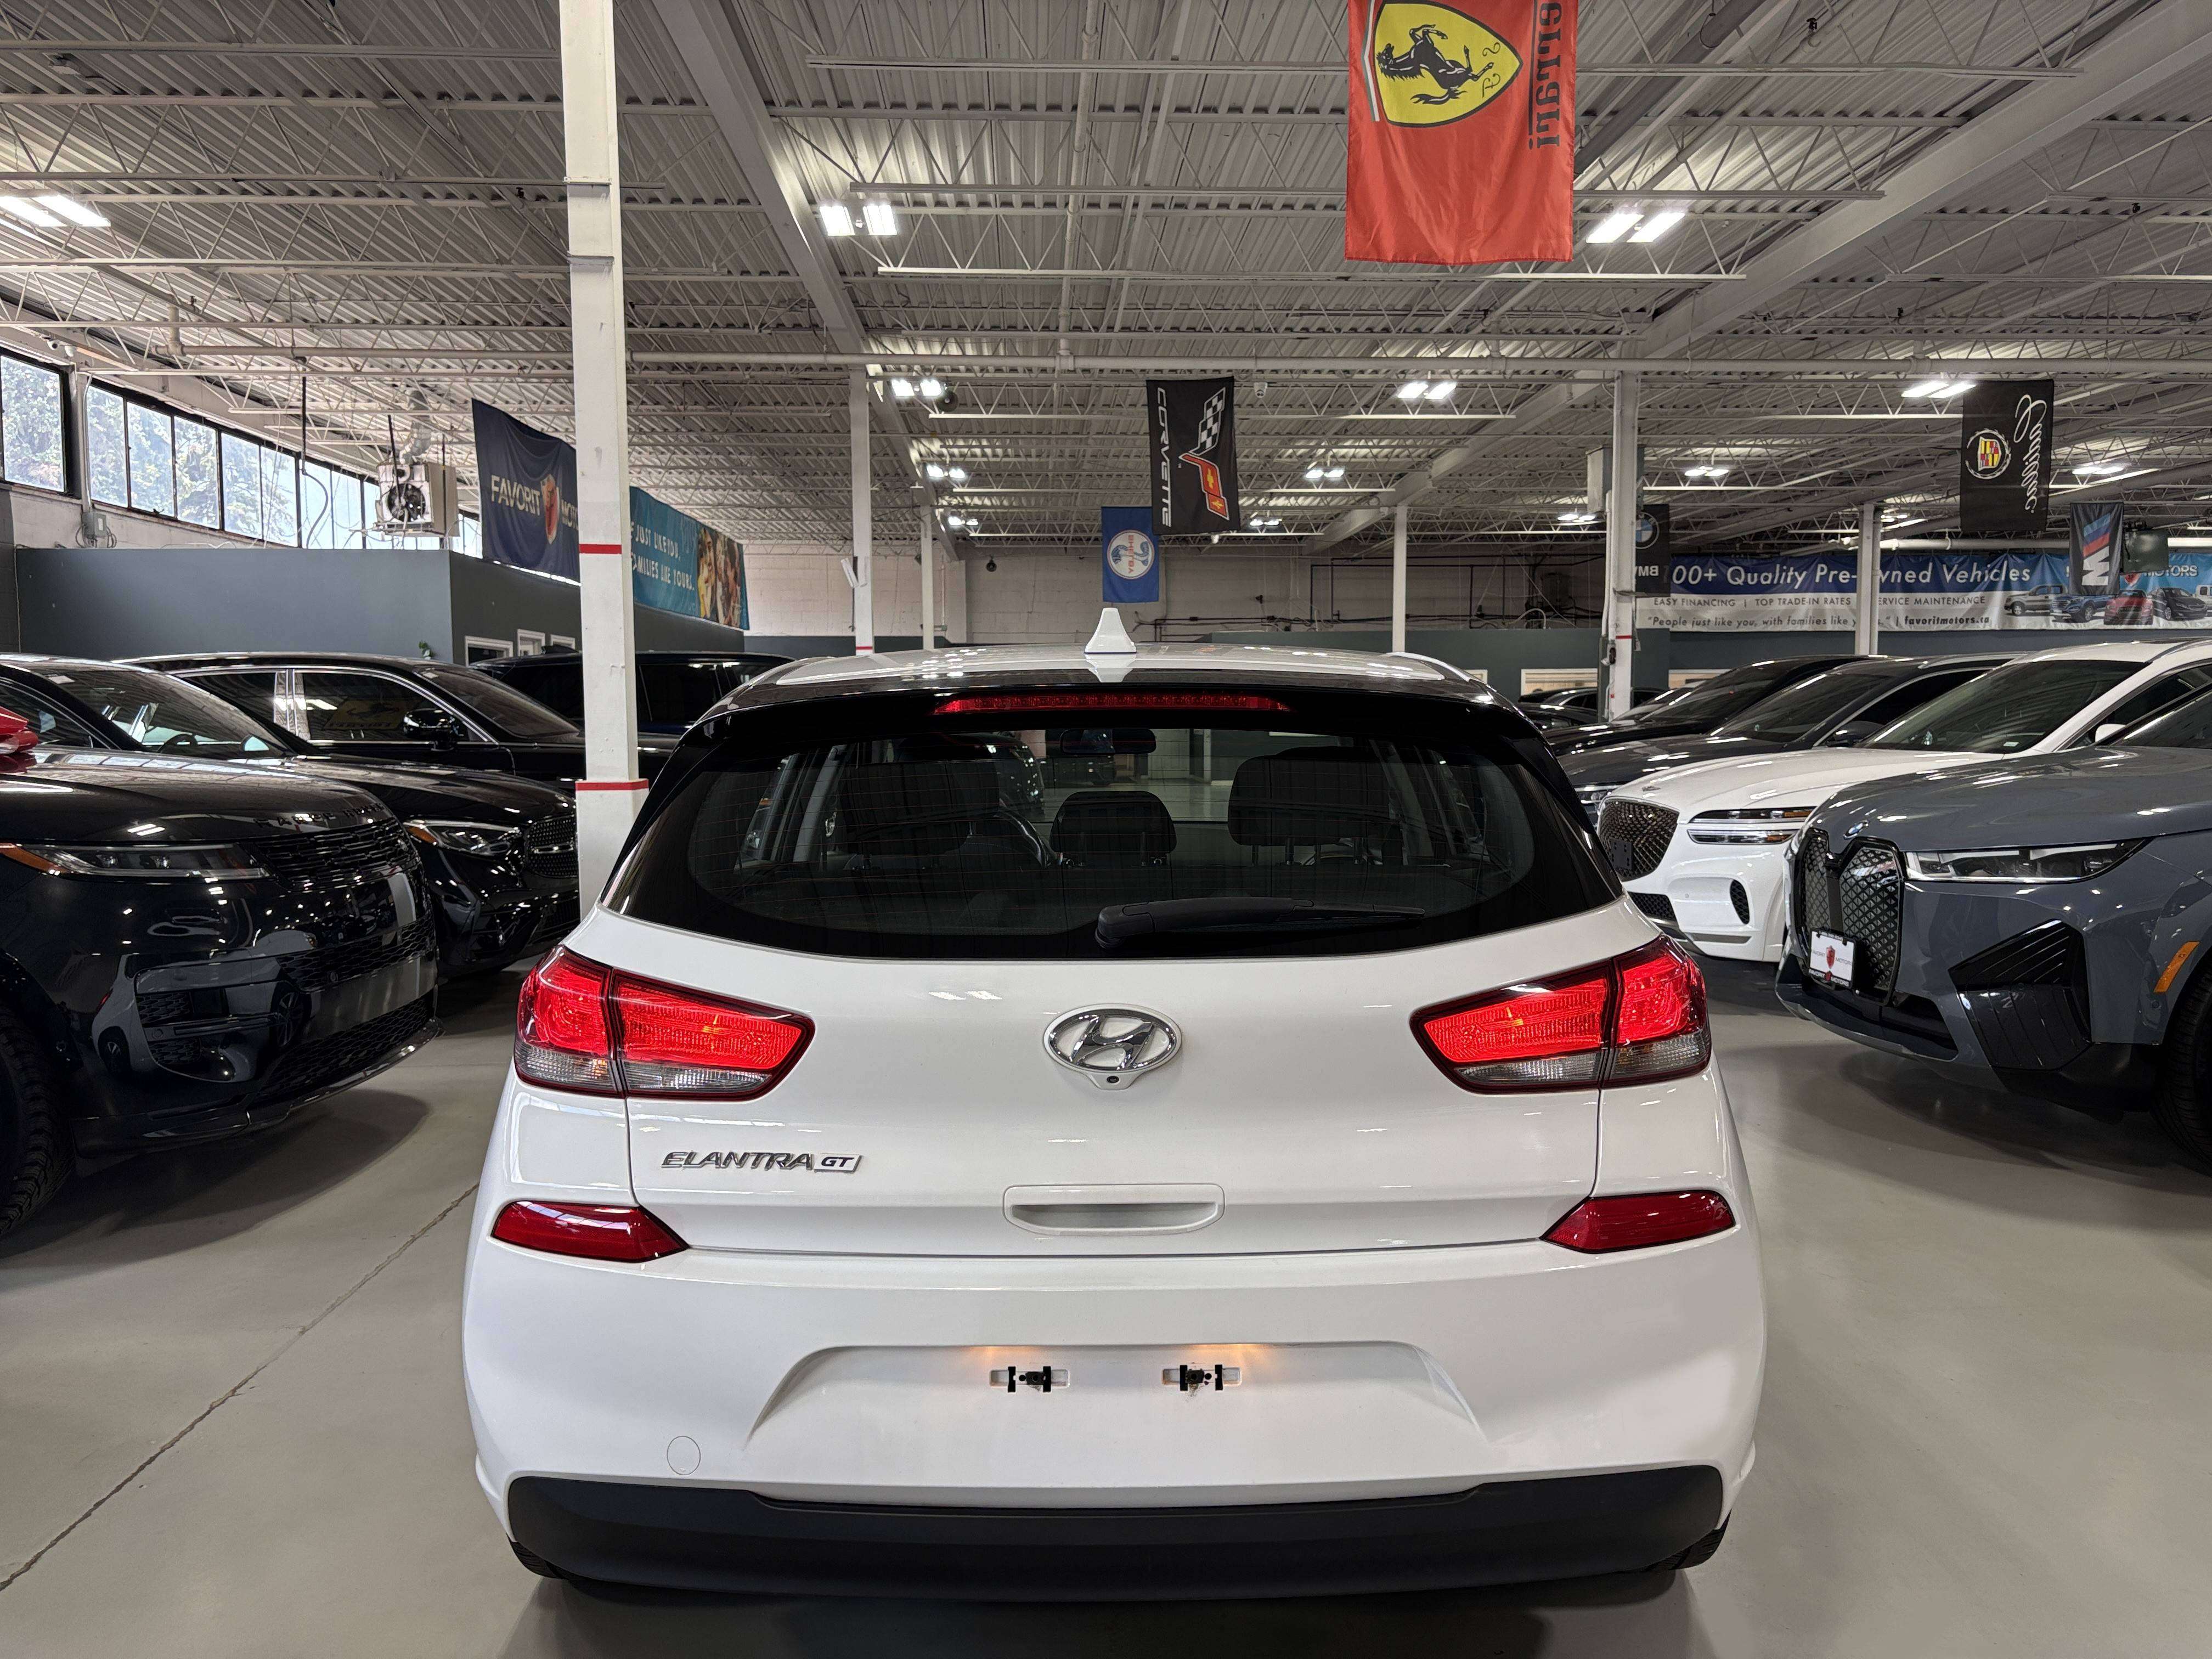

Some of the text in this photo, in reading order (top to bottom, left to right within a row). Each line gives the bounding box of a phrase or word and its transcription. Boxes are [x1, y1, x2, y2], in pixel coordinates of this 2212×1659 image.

[1157, 387, 1172, 527] CORVETTE
[491, 475, 541, 516] FAVORIT
[635, 524, 651, 548] JUST
[631, 551, 659, 580] AMILIES
[1671, 565, 1718, 585] 00+
[1726, 563, 1807, 590] Quality
[1942, 560, 2030, 583] Vehicles
[1654, 598, 1677, 606] EASY
[1681, 599, 1736, 607] FINANCING
[1755, 598, 1774, 606] TOP
[1878, 597, 1910, 605] ERVICE
[1914, 596, 1985, 605] MAINTENANCE
[1691, 617, 1711, 627] just
[1714, 617, 1733, 626] like
[1736, 619, 1757, 628] you,
[1762, 616, 1782, 625] with
[1787, 615, 1826, 625] families
[1831, 615, 1848, 625] like
[1904, 615, 1990, 626] favoritmotors.ca
[660, 1151, 855, 1171] ELANTRA GT
